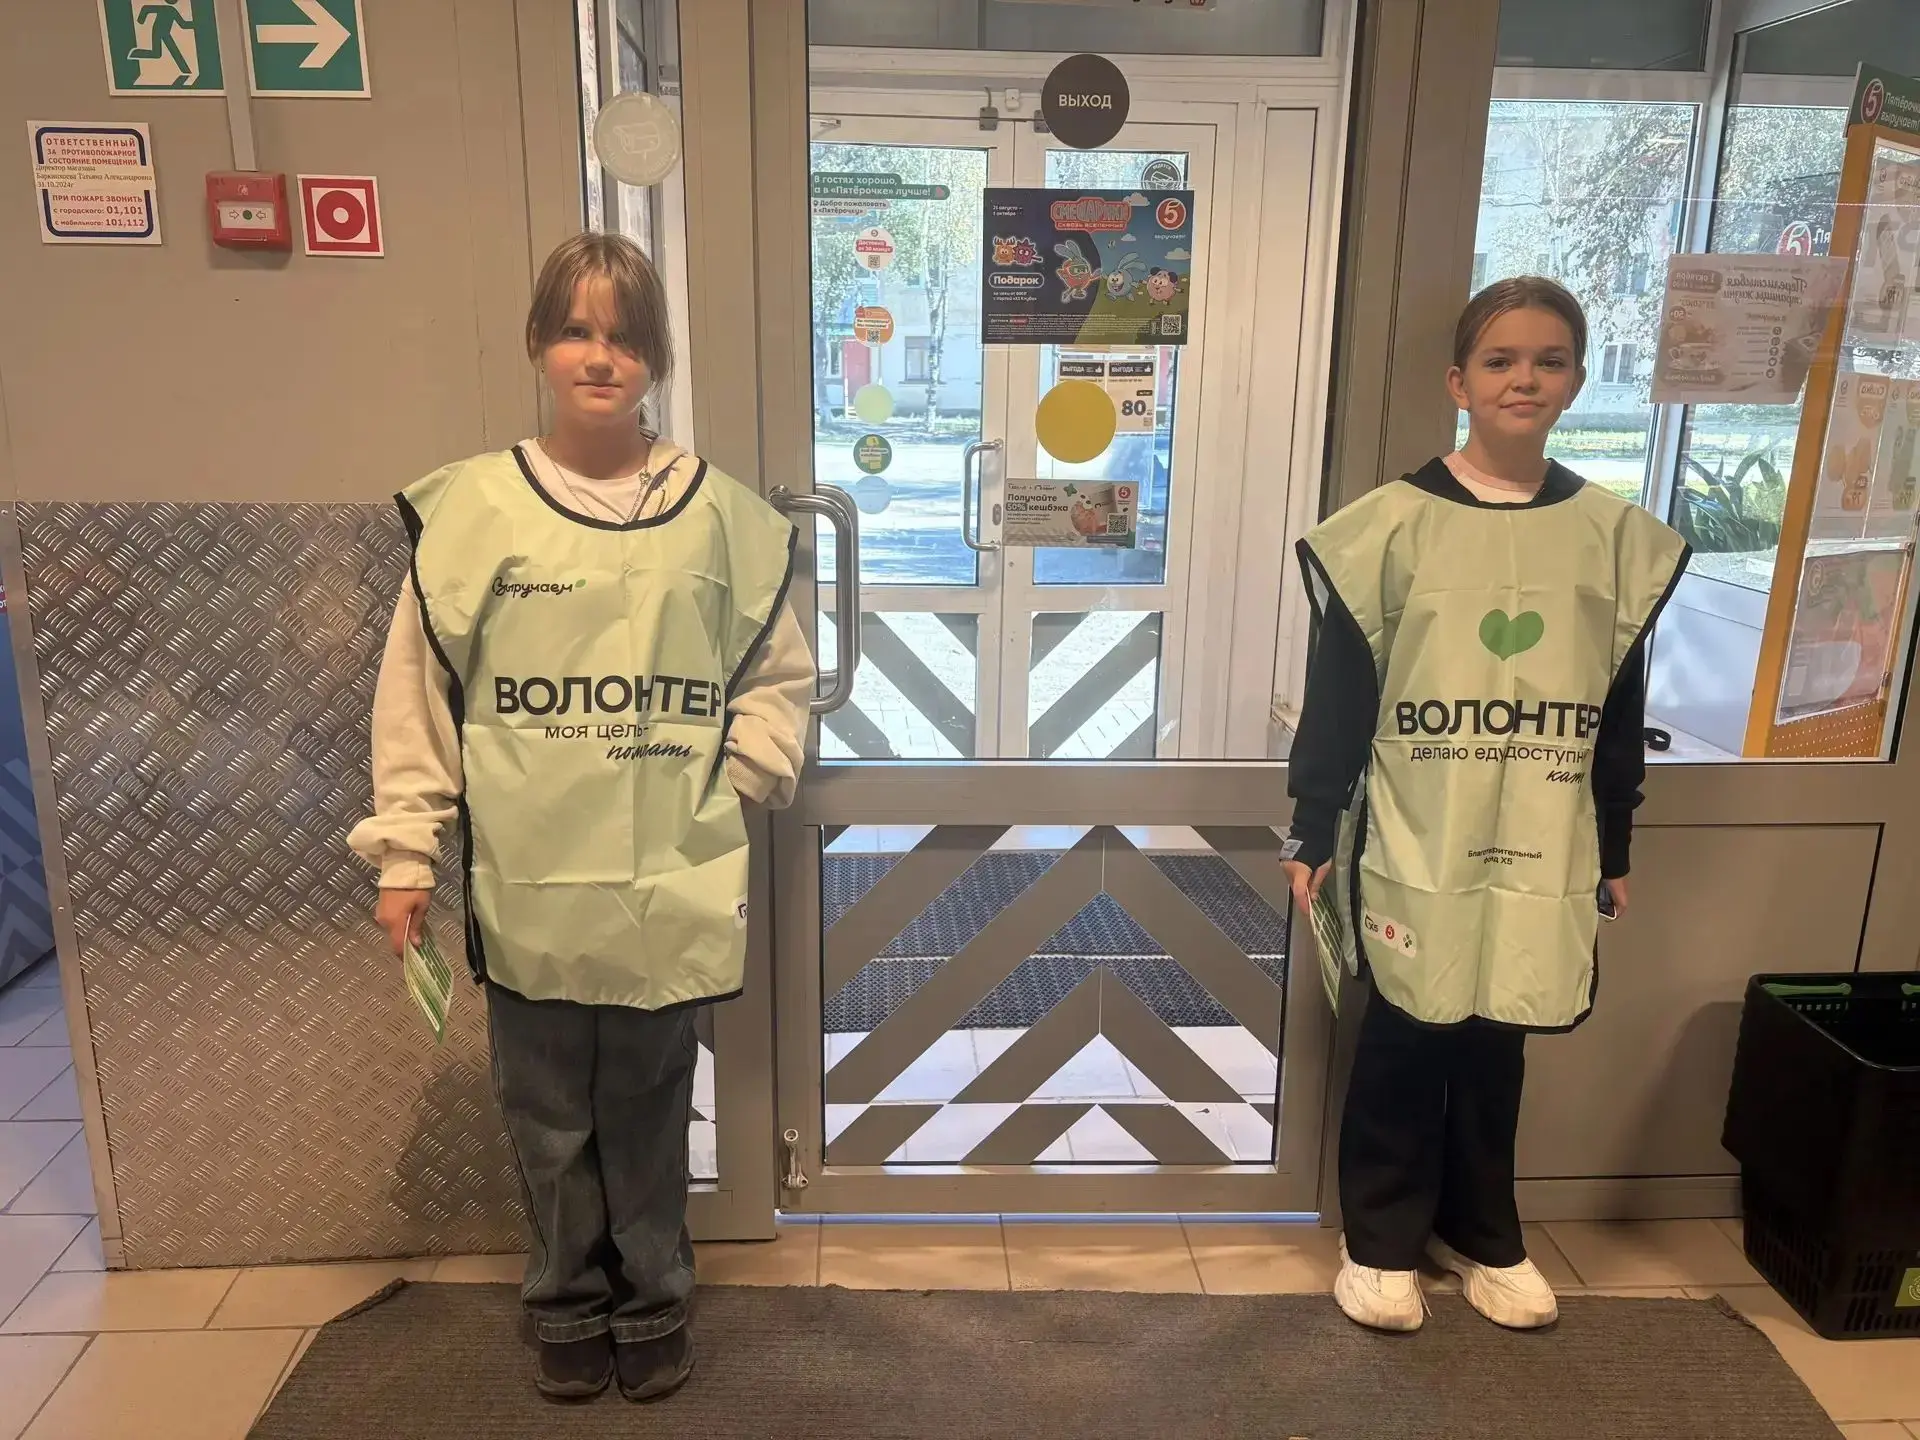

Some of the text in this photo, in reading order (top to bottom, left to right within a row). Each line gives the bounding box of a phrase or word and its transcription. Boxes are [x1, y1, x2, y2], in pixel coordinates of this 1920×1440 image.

[1058, 94, 1112, 109] ВЫХОД
[46, 137, 136, 147] ОТВЕТСТВЕННЫЙ
[61, 149, 137, 157] ПРОТИВОПОЖАРНОЕ
[92, 158, 137, 166] ПОМЕЩЕНИЯ
[814, 176, 820, 184] В
[856, 177, 898, 186] хорошо,
[831, 186, 894, 197] «Пятёрочке»
[895, 189, 931, 197] лучше!
[106, 205, 143, 215] 01,101
[106, 218, 145, 227] 101,112
[993, 275, 1040, 287] Подарок
[1121, 400, 1146, 416] 80
[1007, 493, 1058, 503] Получайте
[1028, 504, 1069, 512] кешбэка
[492, 577, 573, 598] Выручаем
[494, 675, 722, 717] ВОЛОНТЕР
[1396, 700, 1601, 739] ВОЛОНТЕР
[545, 727, 588, 739] моя
[1411, 746, 1590, 766] делаю еду доступн
